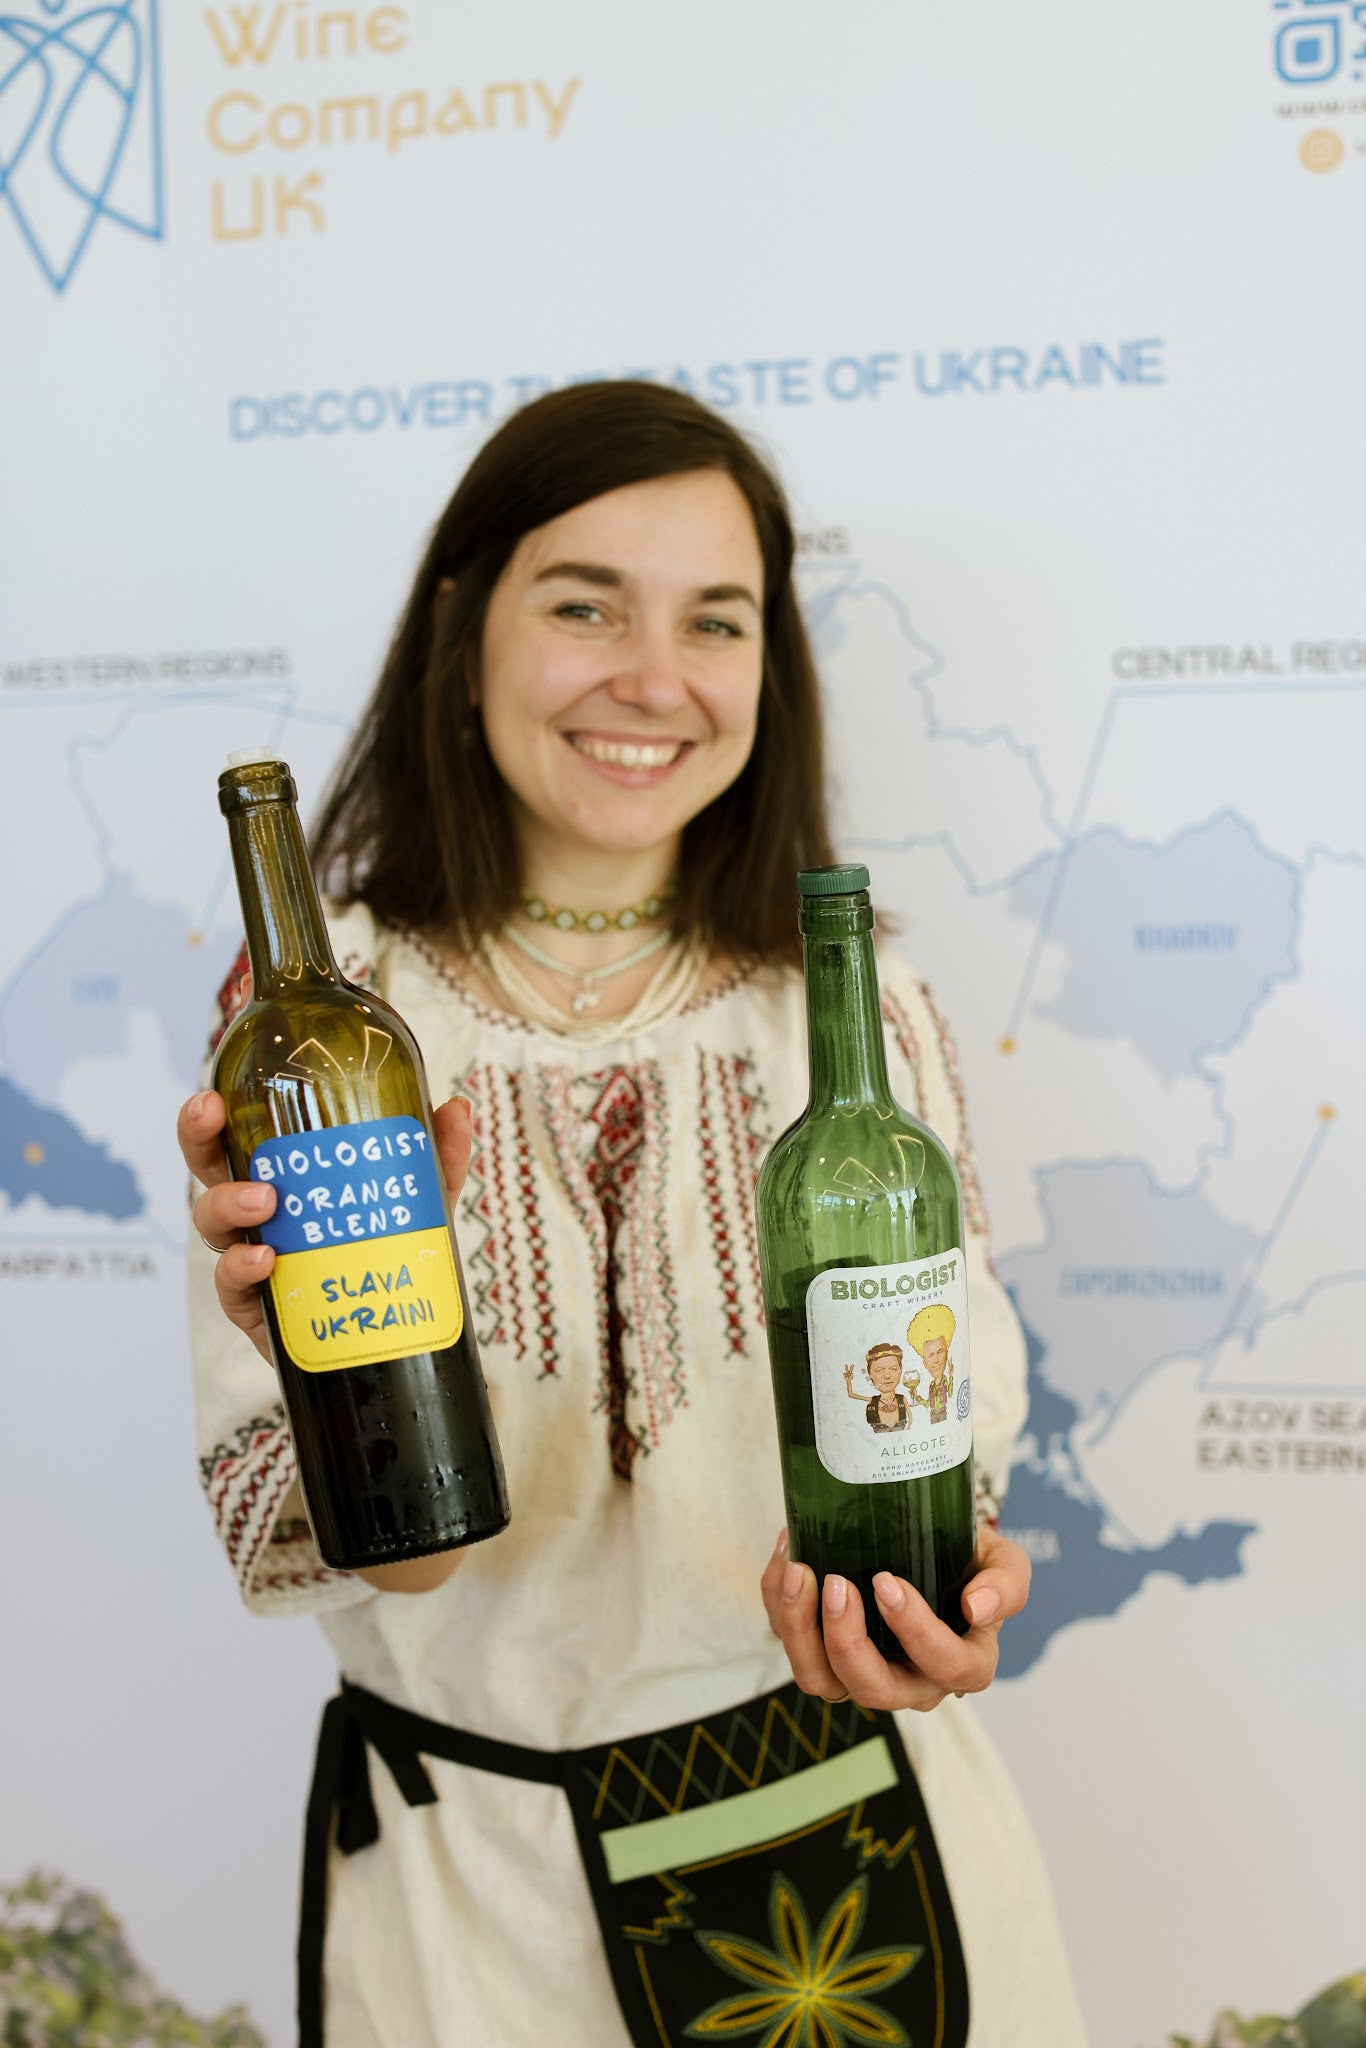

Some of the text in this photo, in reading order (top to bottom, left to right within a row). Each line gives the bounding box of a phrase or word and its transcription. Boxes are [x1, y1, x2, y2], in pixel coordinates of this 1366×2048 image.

[204, 3, 406, 68] Wine
[206, 77, 581, 155] Company
[211, 171, 325, 242] UK
[229, 379, 493, 441] DISCOVER
[621, 357, 811, 410] ASTE
[824, 352, 899, 401] OF
[914, 338, 1164, 397] UKRAINE
[1112, 645, 1283, 680] CENTRAL
[253, 1131, 428, 1182] BIOLOGIST
[284, 1173, 419, 1218] ORANGE
[302, 1205, 412, 1244] BLEND
[321, 1264, 414, 1303] SLAVA
[830, 1259, 958, 1301] BIOLOGIST
[862, 1290, 944, 1310] CRAFT WINERY
[311, 1297, 436, 1342] UKRAINI
[1200, 1402, 1302, 1433] AZOV
[880, 1435, 946, 1458] ALIGOTE
[881, 1463, 902, 1471] ВИНО
